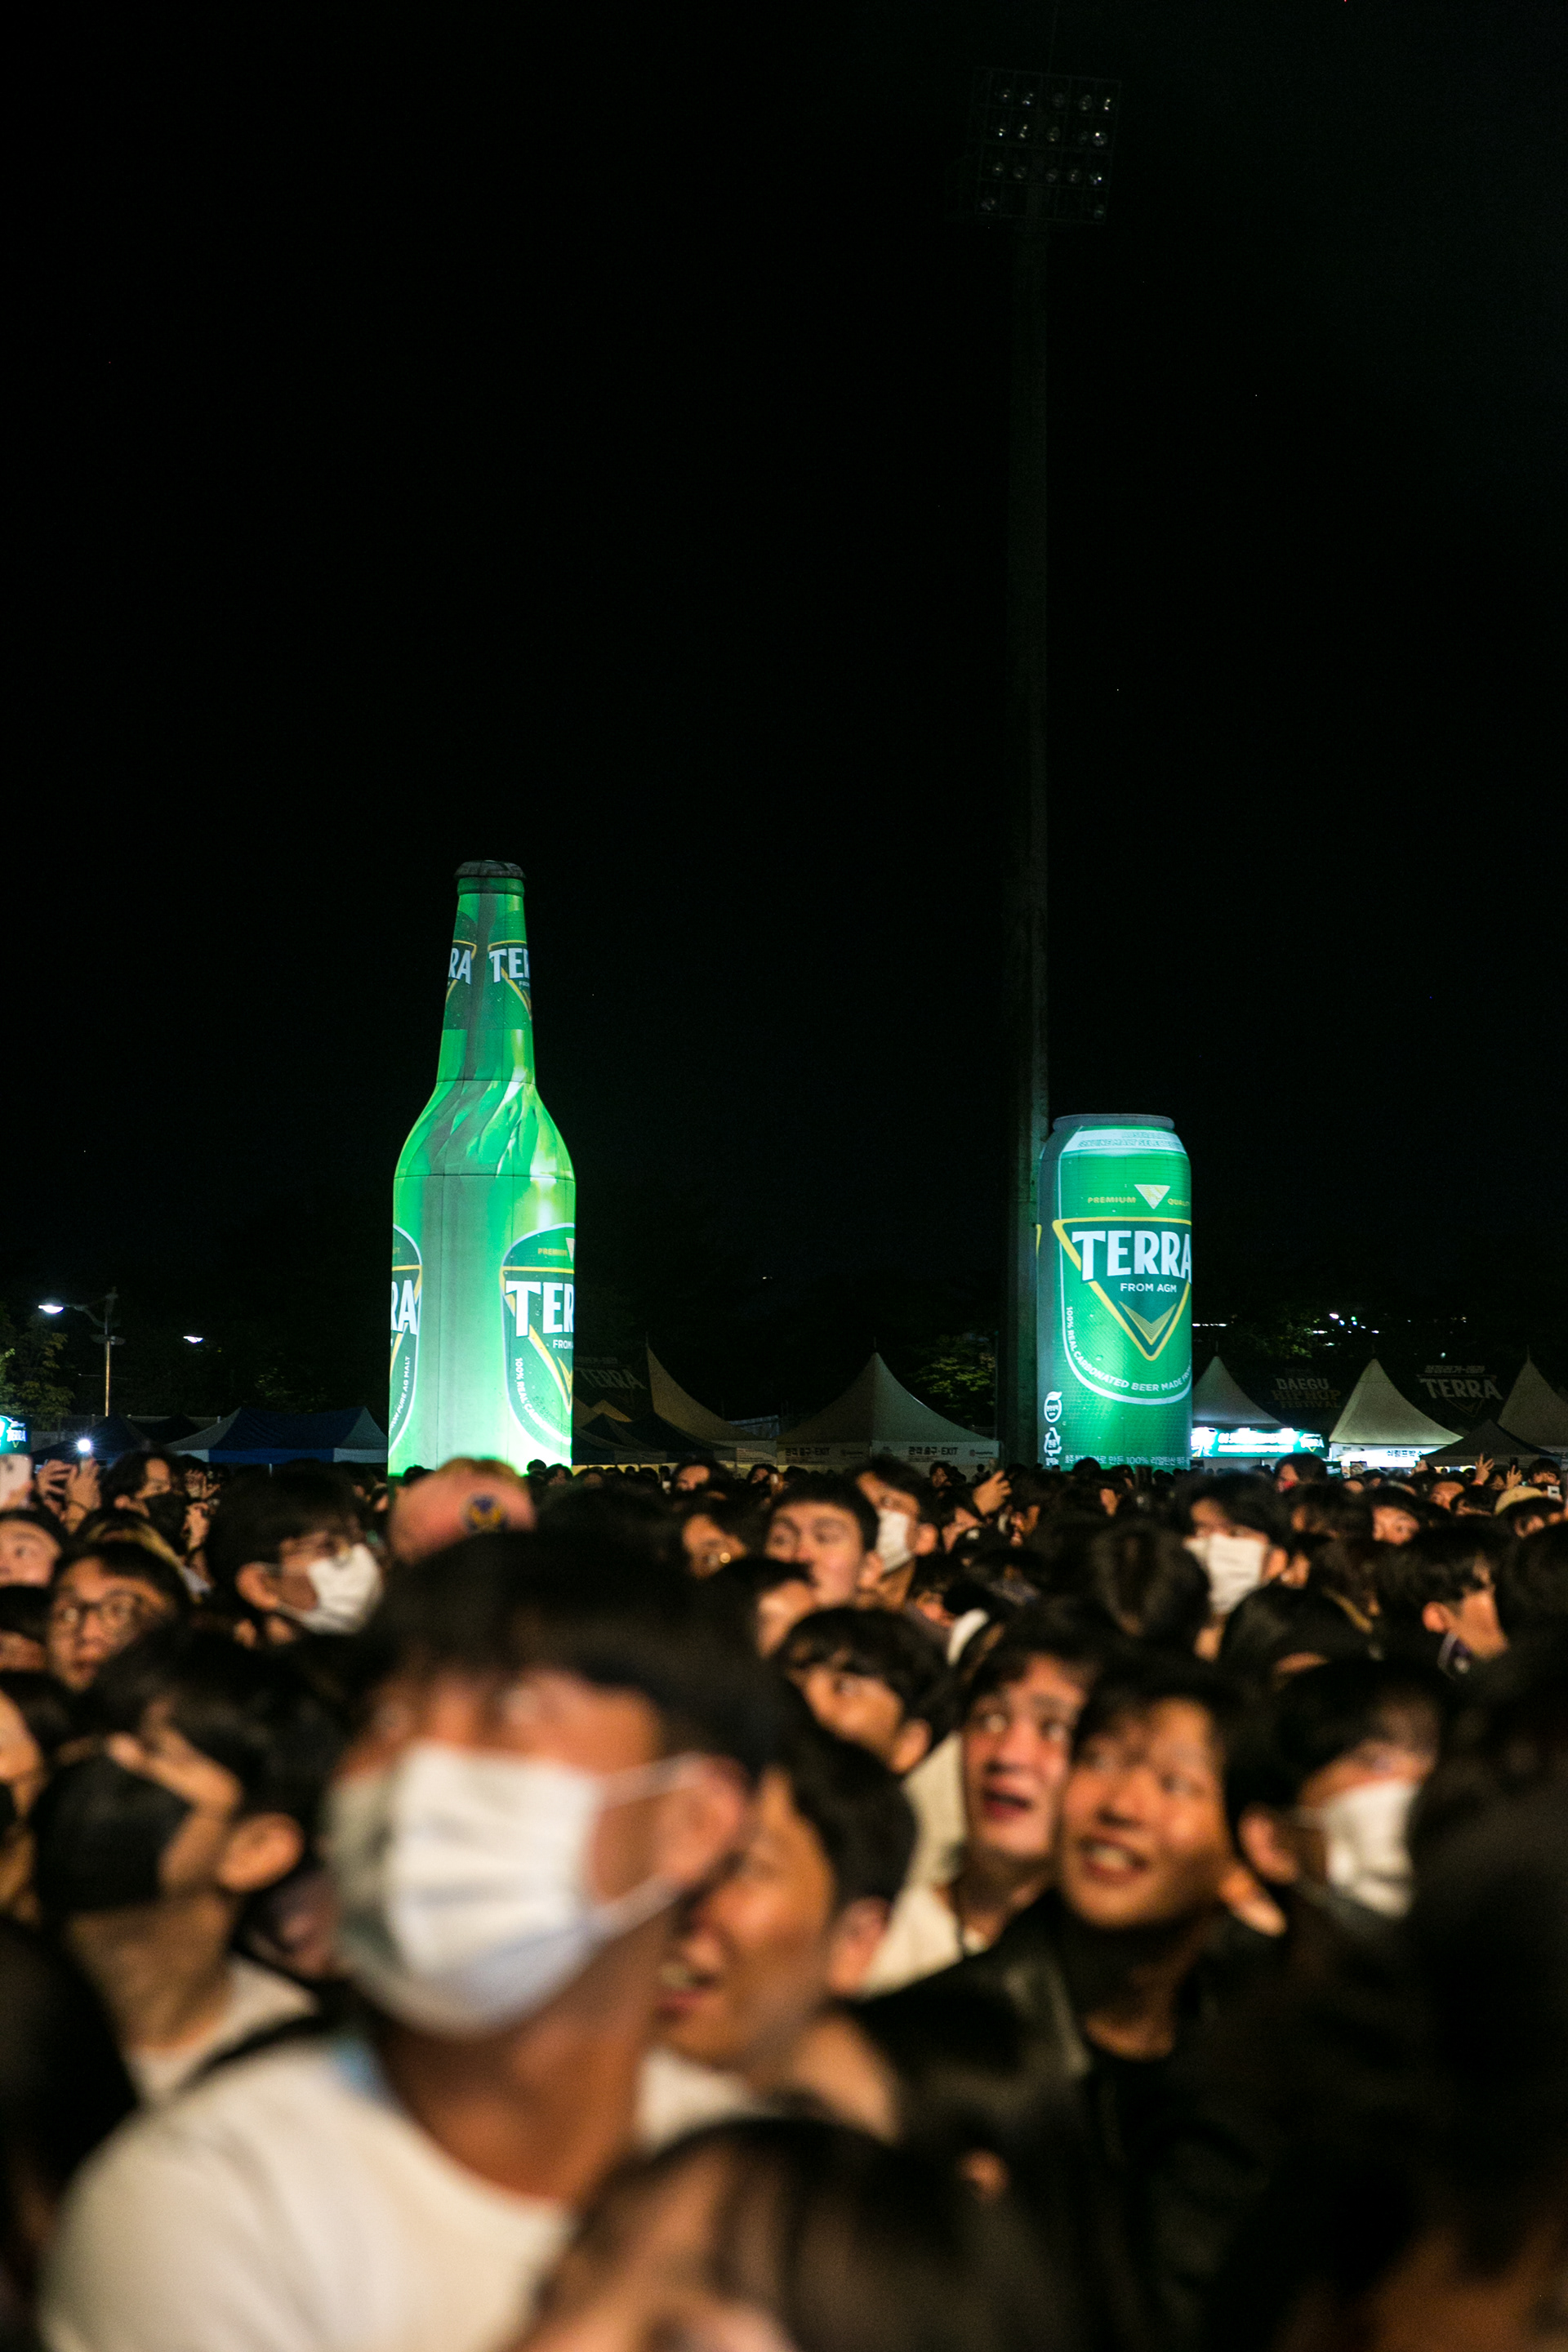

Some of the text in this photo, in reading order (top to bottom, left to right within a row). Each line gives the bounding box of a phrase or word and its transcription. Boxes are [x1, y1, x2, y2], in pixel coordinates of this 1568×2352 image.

[1071, 1230, 1192, 1284] TERRA
[1120, 1283, 1177, 1293] FROM AGM
[1066, 1306, 1074, 1329] 100%
[1073, 1351, 1129, 1388] CARBONATED
[1131, 1383, 1160, 1392] BEER
[1160, 1377, 1183, 1391] MADE
[515, 1357, 524, 1380] 100%
[1275, 1378, 1330, 1390] DAEGU
[1419, 1378, 1503, 1400] TERRA
[397, 1392, 407, 1414] PURE
[1108, 1455, 1125, 1465] 만든
[1126, 1456, 1149, 1464] 100%
